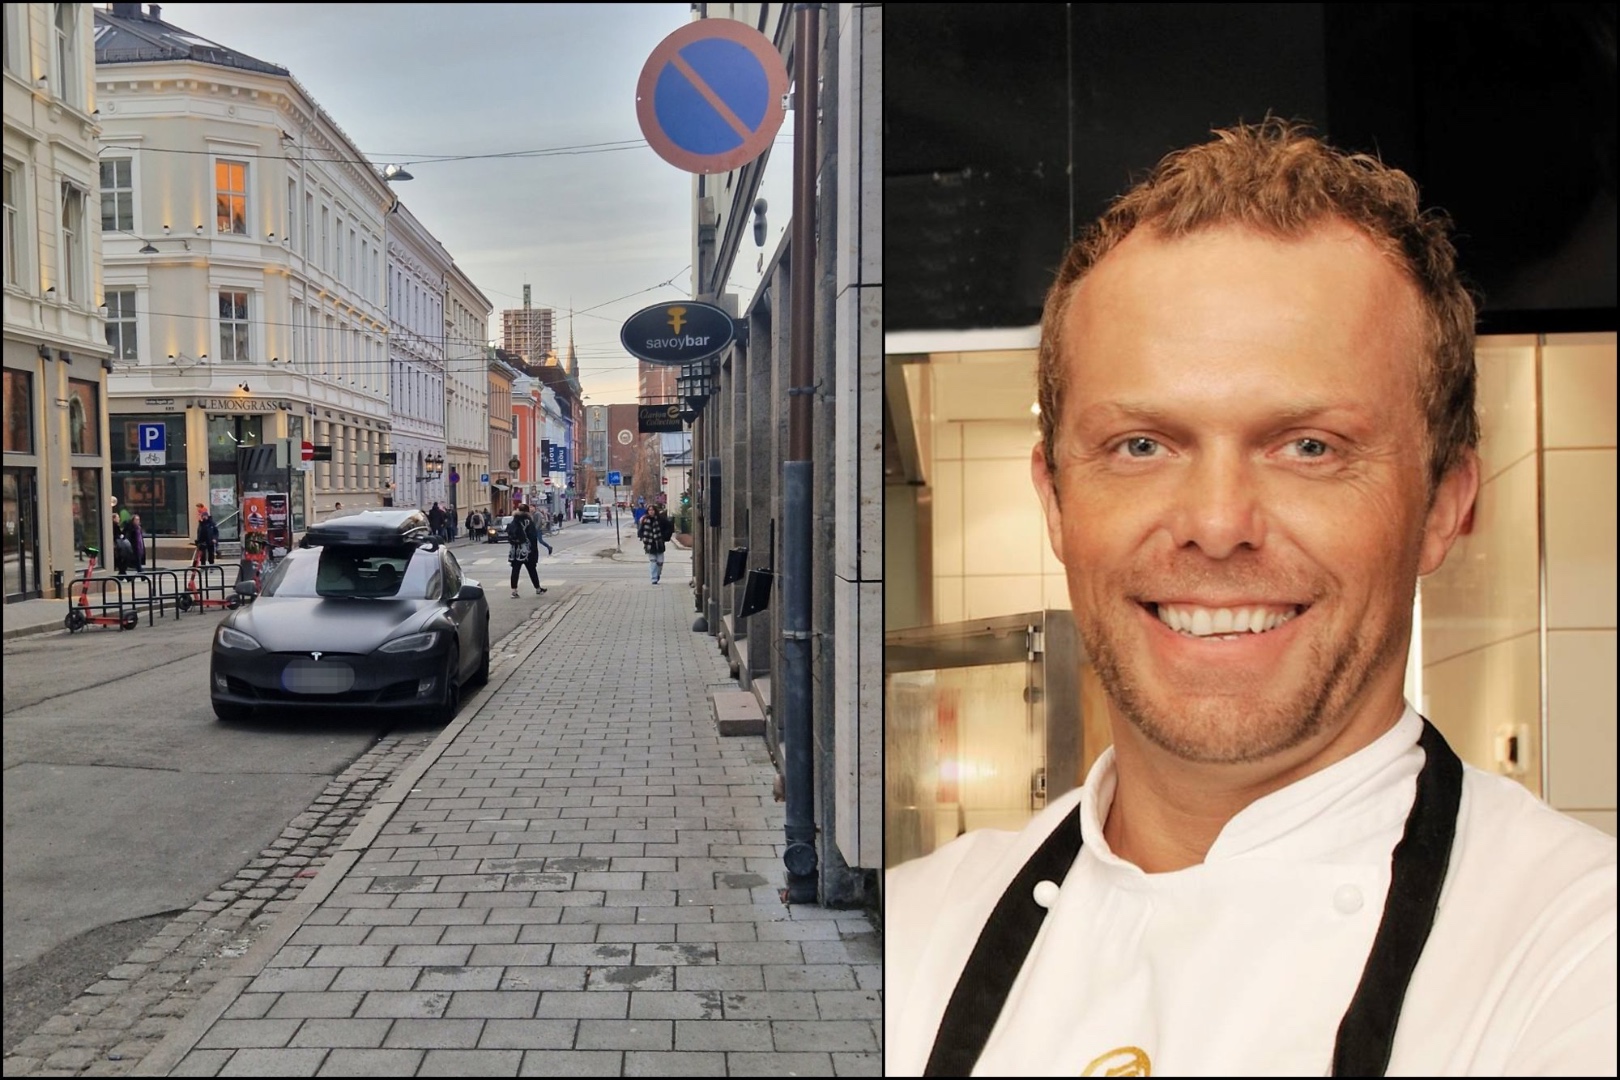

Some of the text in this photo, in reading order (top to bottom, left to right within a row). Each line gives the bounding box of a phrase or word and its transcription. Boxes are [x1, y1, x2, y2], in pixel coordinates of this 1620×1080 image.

[646, 335, 710, 350] savoybar
[205, 399, 278, 411] LEMONGRASS
[145, 427, 159, 448] P
[549, 447, 557, 468] norli
